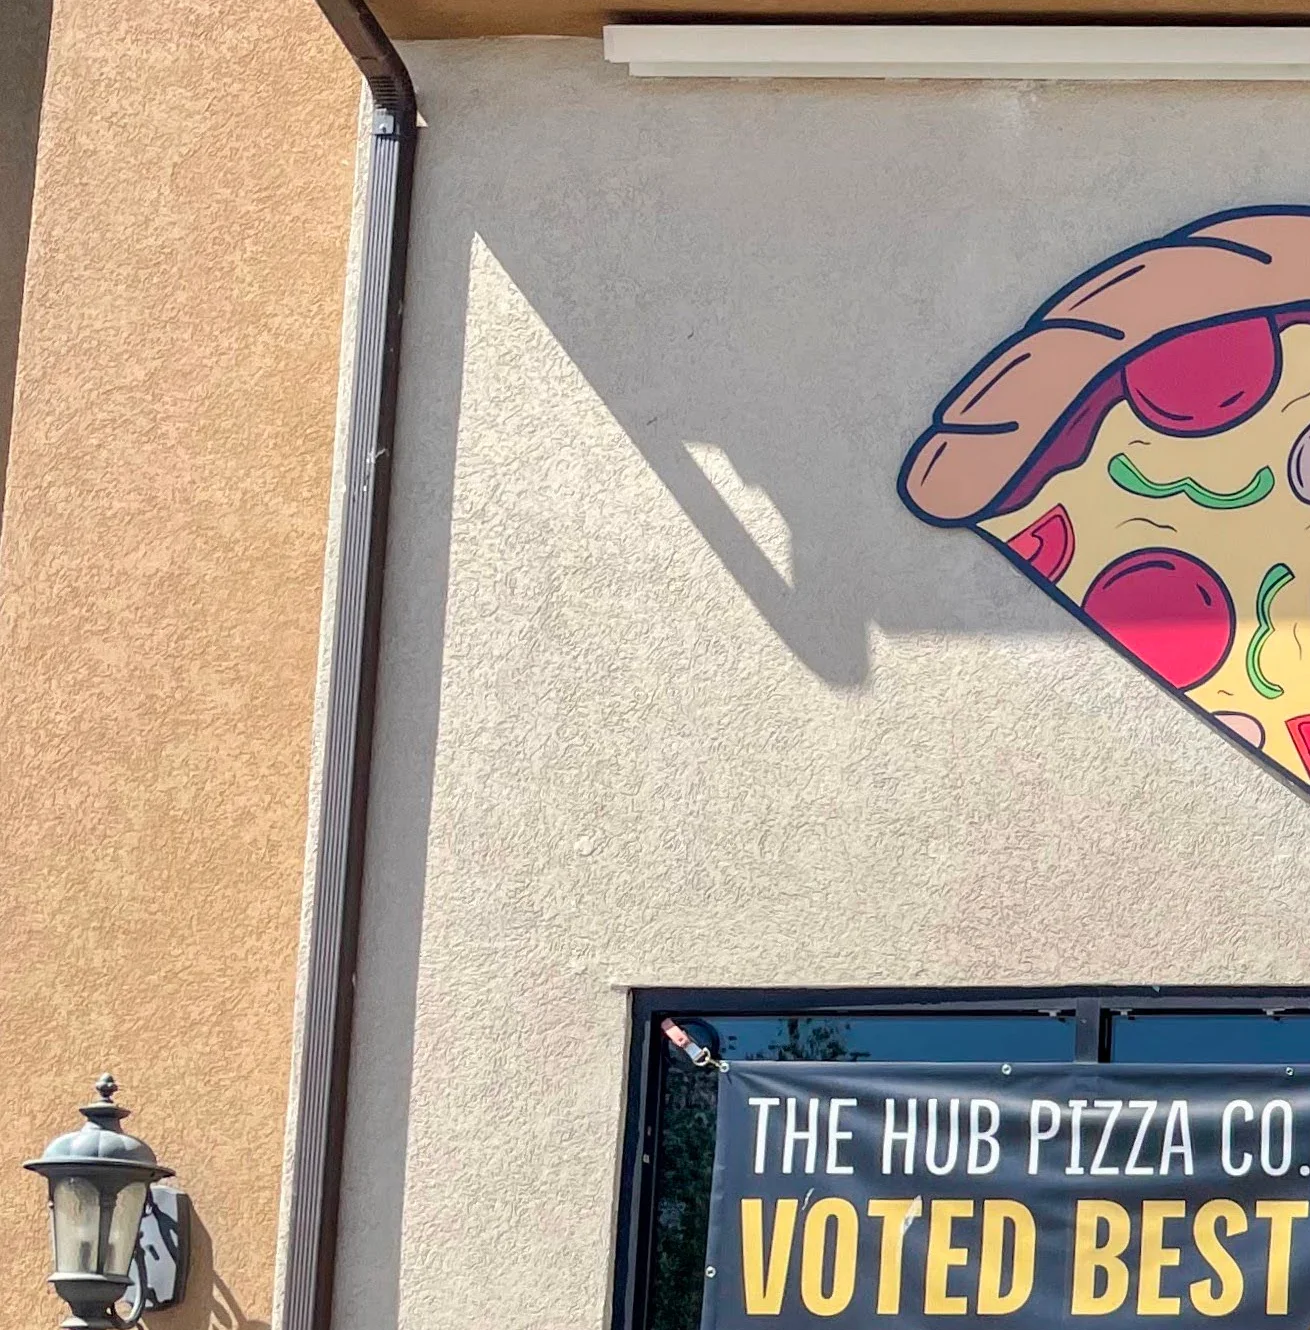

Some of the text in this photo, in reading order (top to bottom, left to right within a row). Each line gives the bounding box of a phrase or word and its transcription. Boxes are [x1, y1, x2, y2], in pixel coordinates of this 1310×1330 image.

[748, 1097, 1310, 1177] THE HUB PIZZA CO.
[740, 1198, 1310, 1316] VOTED BEST
